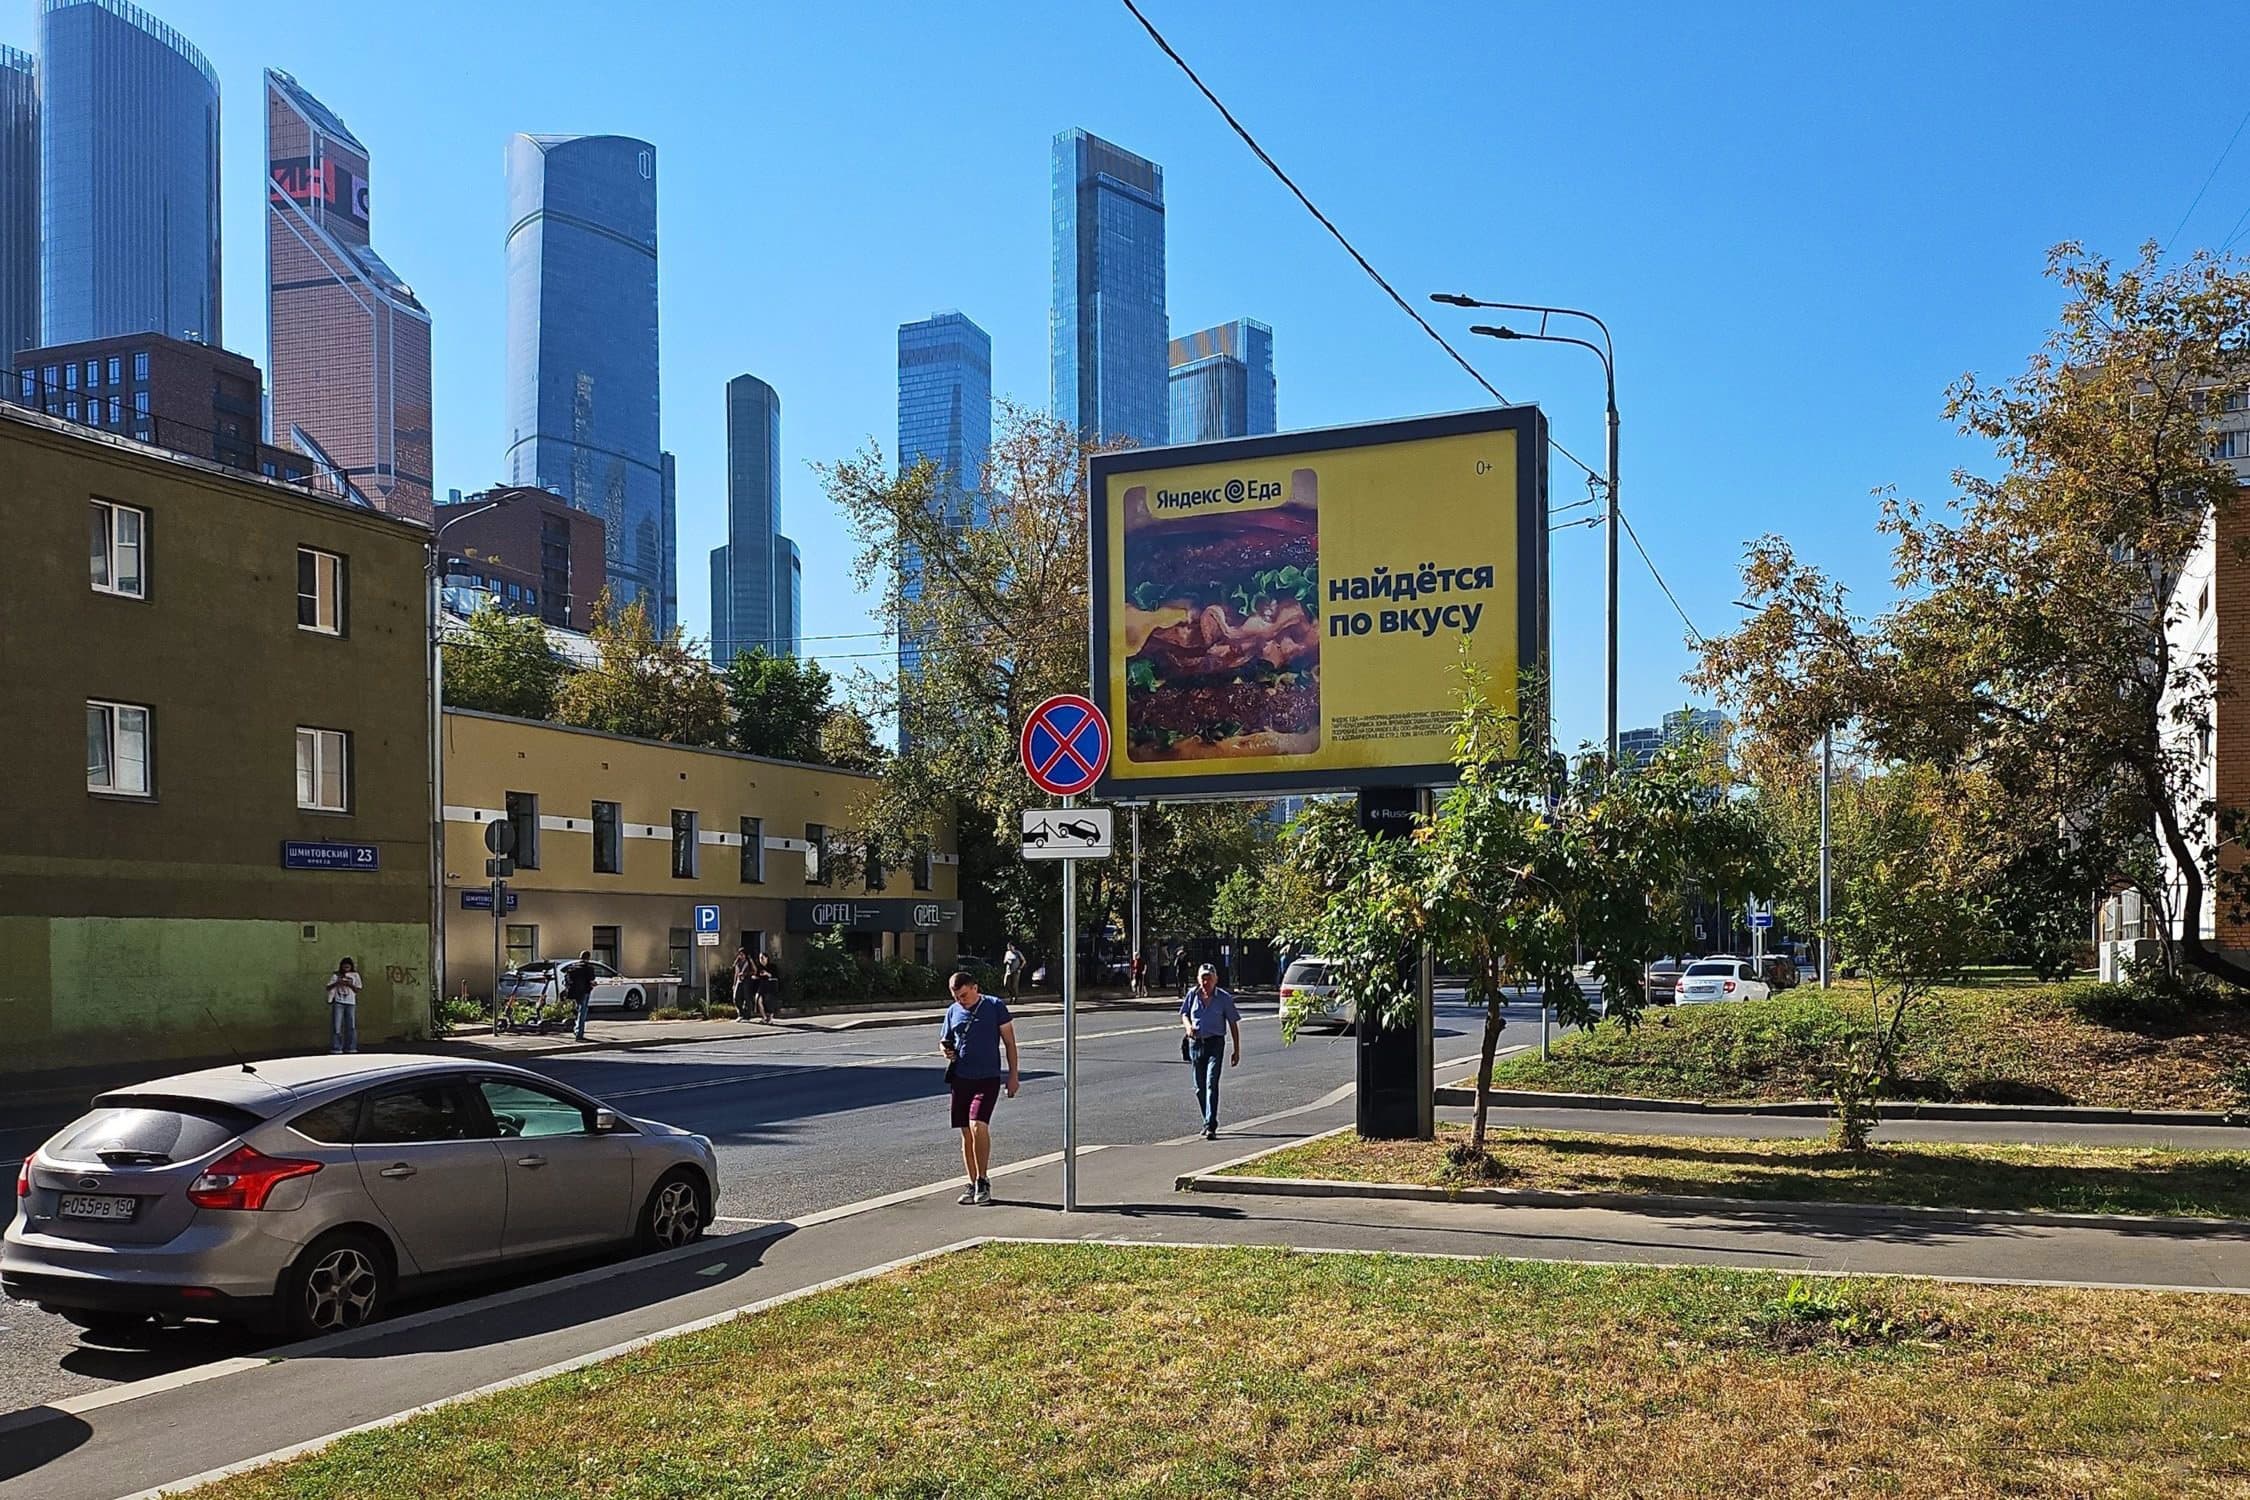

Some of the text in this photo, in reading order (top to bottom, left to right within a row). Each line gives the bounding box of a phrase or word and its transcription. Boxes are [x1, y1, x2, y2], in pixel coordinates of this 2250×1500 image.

[1476, 460, 1493, 475] 0+
[1157, 480, 1282, 509] Яндекс Еда
[1329, 562, 1494, 602] найдётся
[1330, 603, 1483, 637] по вкусу
[289, 848, 372, 862] ШМИТОВСКИЙ 23
[114, 1199, 133, 1212] 150
